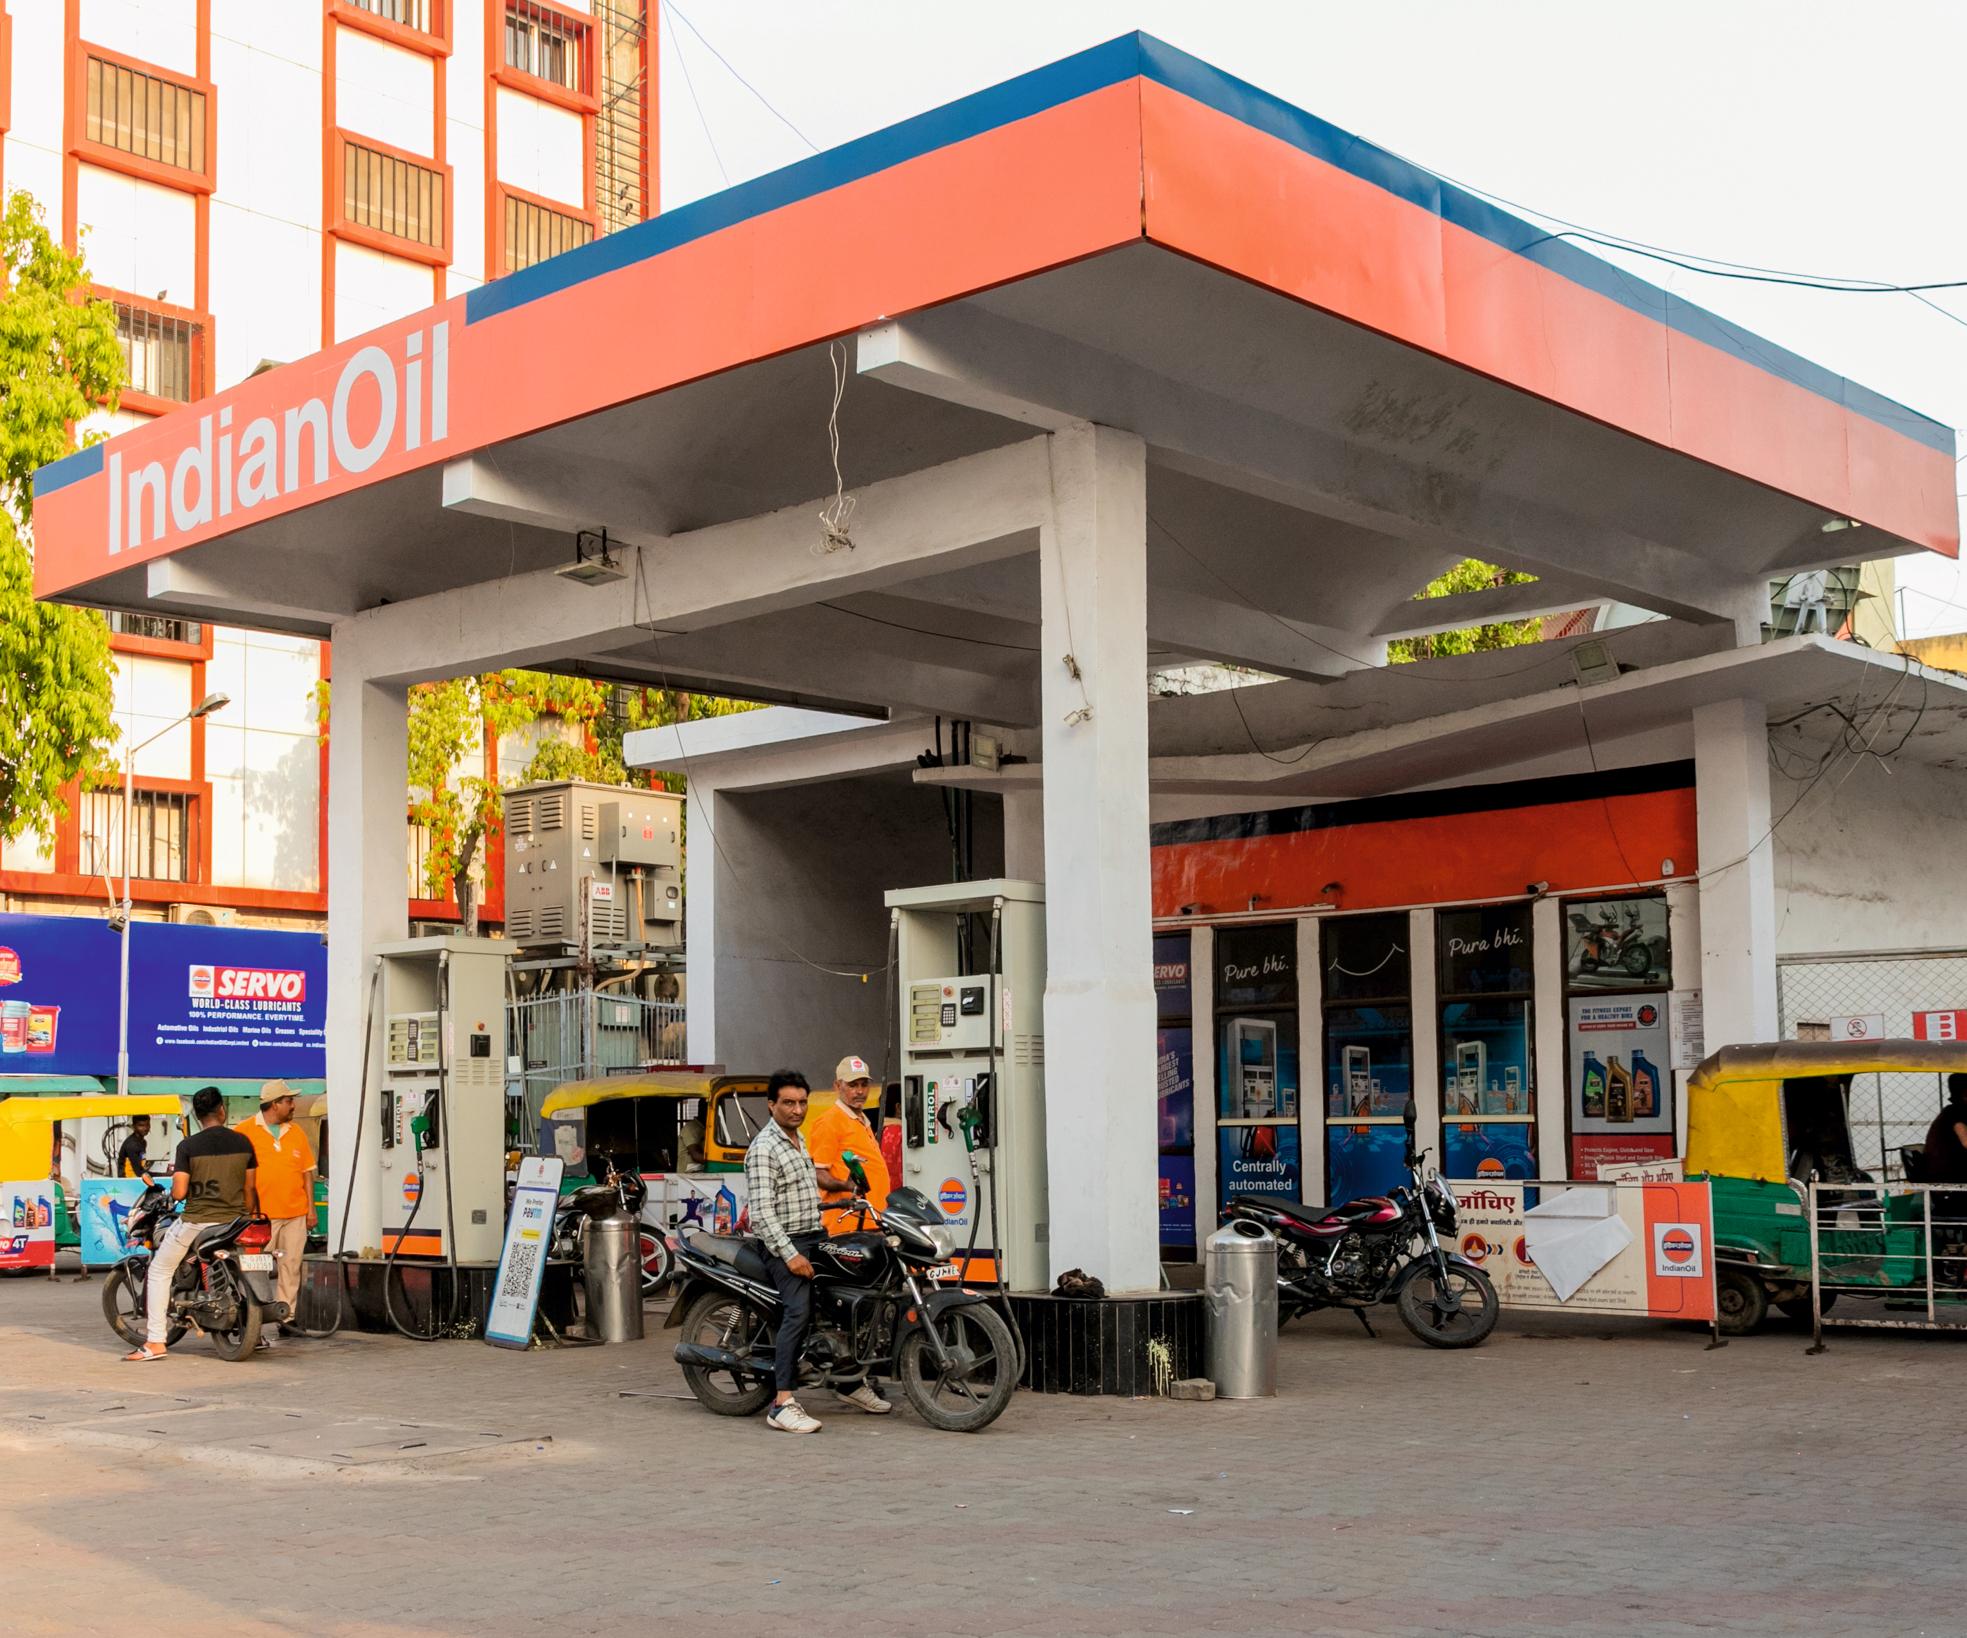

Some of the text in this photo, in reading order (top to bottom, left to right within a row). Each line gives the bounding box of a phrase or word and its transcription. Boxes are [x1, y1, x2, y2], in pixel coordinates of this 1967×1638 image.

[108, 319, 449, 556] IndianOil
[595, 887, 611, 896] ABB
[1449, 937, 1490, 957] Pura
[1155, 964, 1185, 979] ERVO
[1224, 964, 1260, 983] Pure
[217, 969, 303, 999] SERVO
[191, 998, 302, 1012] WORLD-CLASS LUBRICANTS
[1232, 1160, 1287, 1176] Centrally
[1228, 1178, 1293, 1191] automated
[943, 1217, 968, 1226] dianOil
[12, 1238, 27, 1250] 4T
[1662, 1264, 1696, 1272] IndianOil
